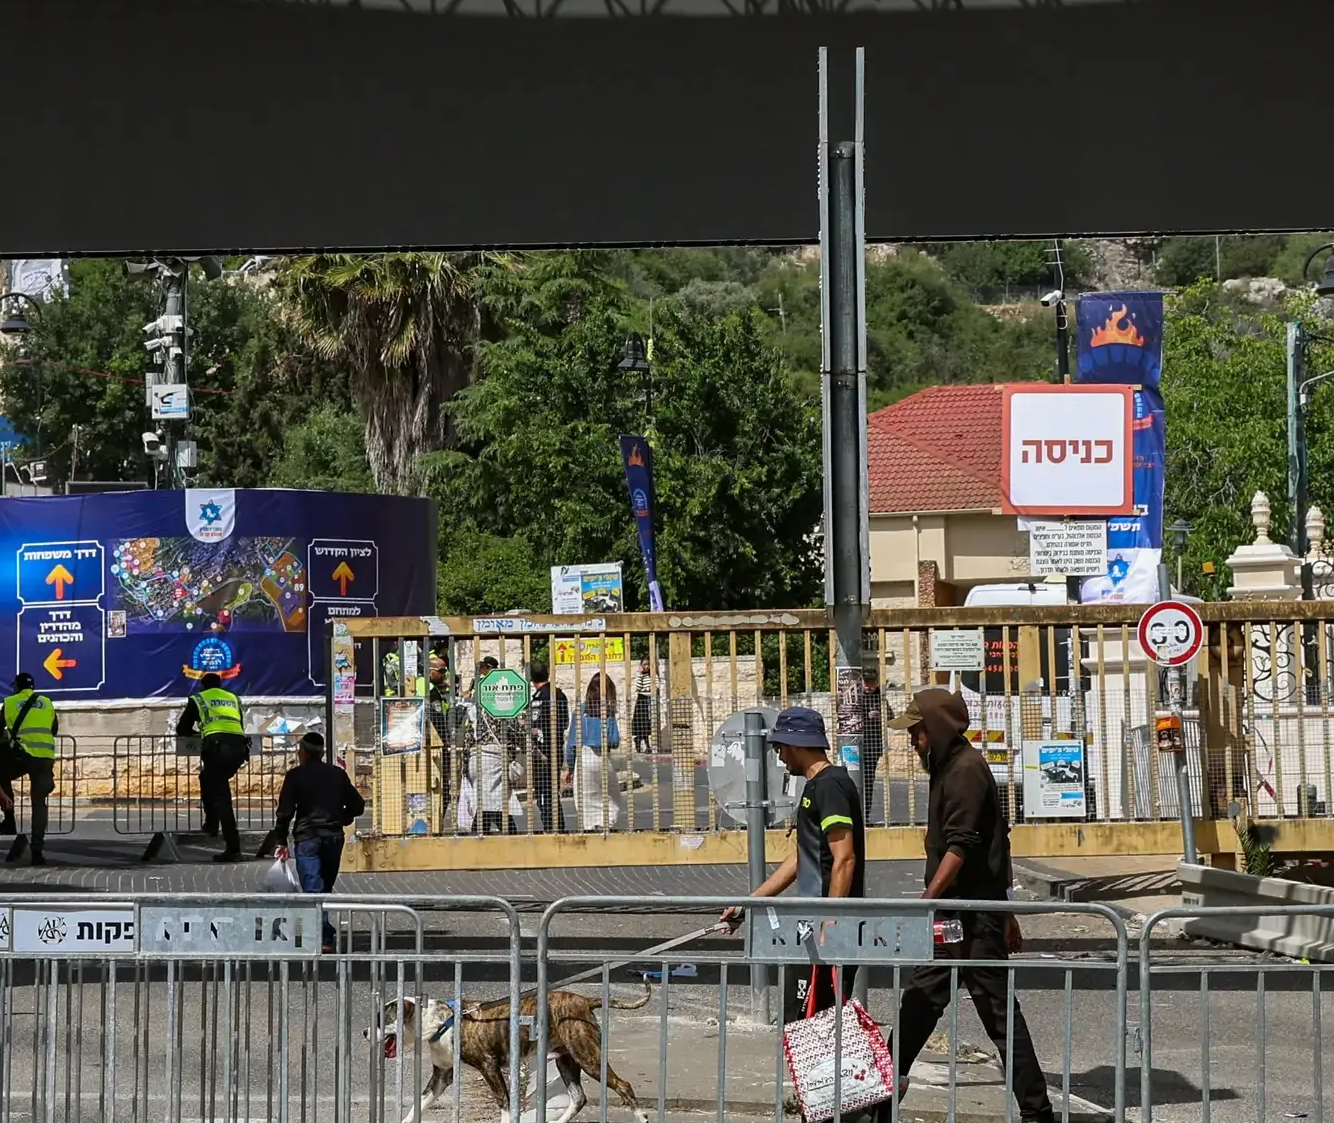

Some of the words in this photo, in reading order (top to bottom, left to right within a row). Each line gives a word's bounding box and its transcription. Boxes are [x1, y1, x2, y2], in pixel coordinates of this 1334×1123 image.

[1021, 439, 1114, 464] כניסה
[23, 551, 71, 561] משפחות
[74, 548, 97, 560] דרך
[314, 547, 347, 558] הקדוש
[349, 546, 372, 558] לציון
[48, 610, 71, 621] דרך
[40, 621, 82, 633] מהדרין
